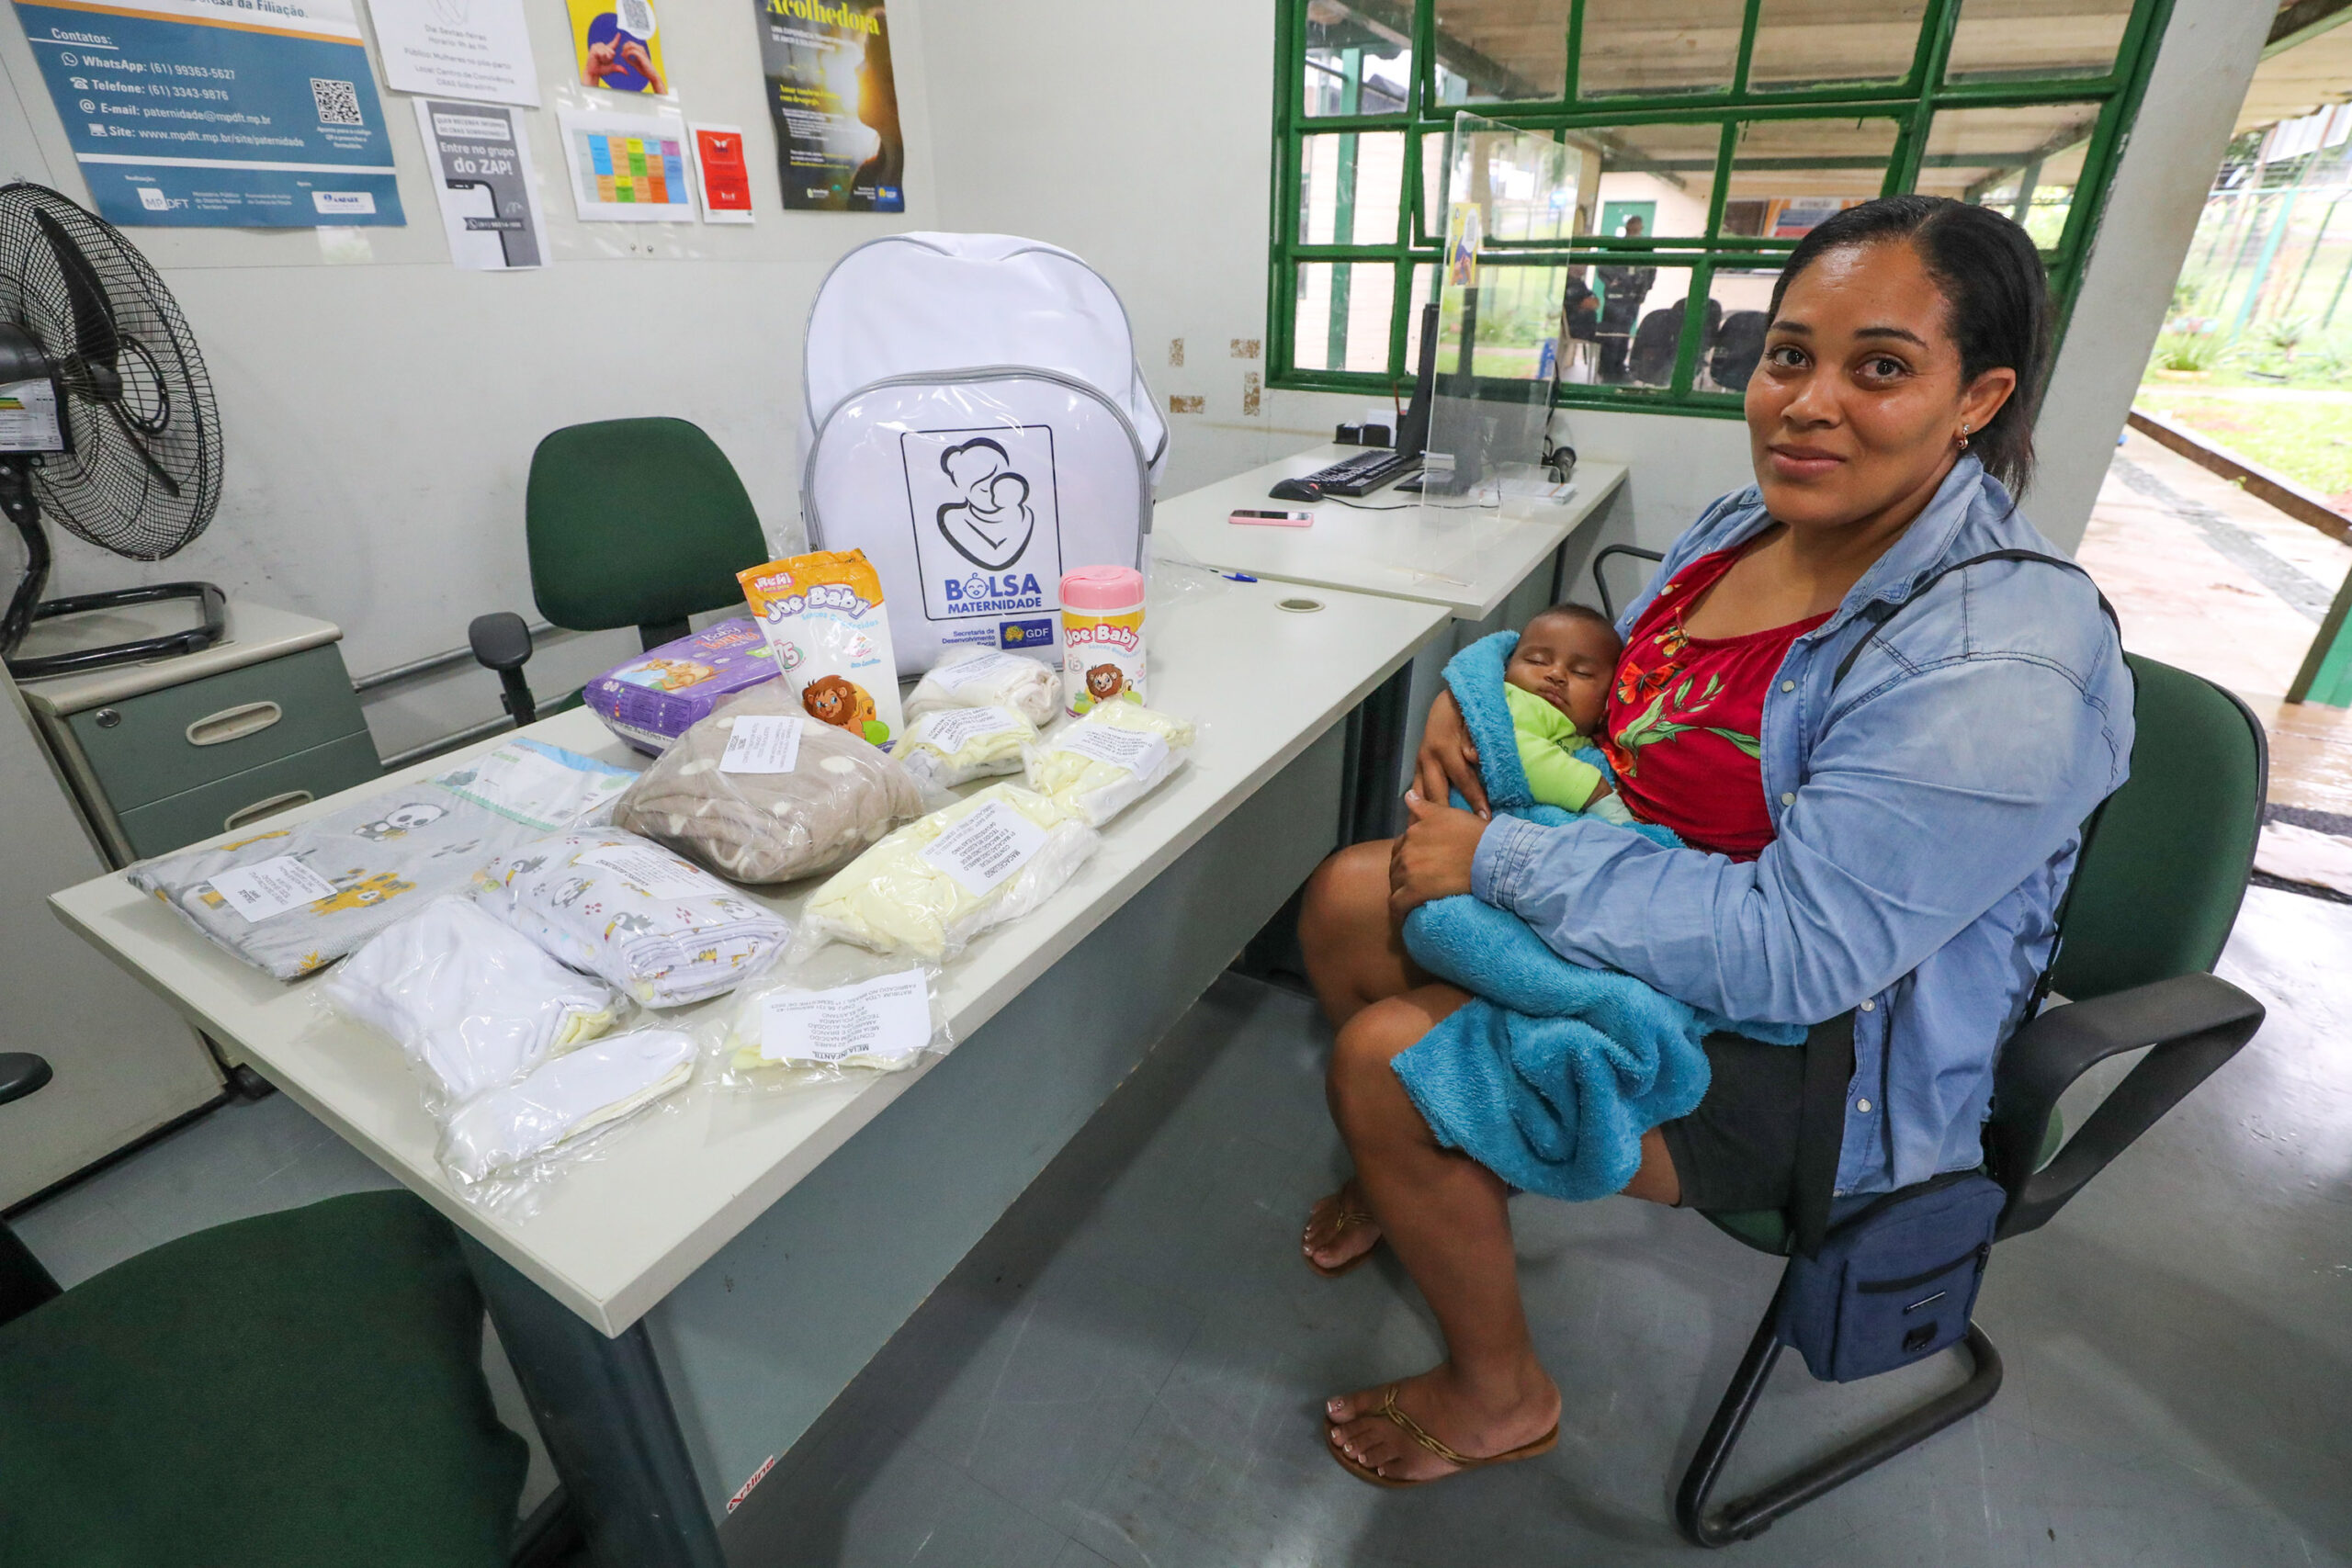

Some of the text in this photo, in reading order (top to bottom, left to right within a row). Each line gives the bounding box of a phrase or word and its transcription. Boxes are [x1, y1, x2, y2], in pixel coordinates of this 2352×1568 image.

[257, 0, 309, 18] Filiação.
[51, 28, 112, 44] Contatos:
[82, 55, 235, 80] WhatsApp: (61) 99363-5627
[91, 79, 229, 101] Telefone: (61) 3343-9876
[100, 103, 271, 125] E-mail: paternidade@mpdft.mp.br
[108, 126, 135, 137] Site:
[138, 130, 305, 147] www.mpdft.mp.br/site/paternidade
[440, 141, 515, 159] Entre no grupo
[454, 157, 514, 175] do ZAP!
[756, 571, 792, 588] Refil
[764, 585, 871, 625] Joe Baby
[947, 597, 1042, 615] MATERNIDADE
[942, 635, 996, 645] Desenvolvimento
[953, 628, 986, 637] Secretaria
[1025, 627, 1049, 638] GDF
[1066, 624, 1139, 652] Joe Baby
[811, 1043, 869, 1060] MEIA INFANTIL
